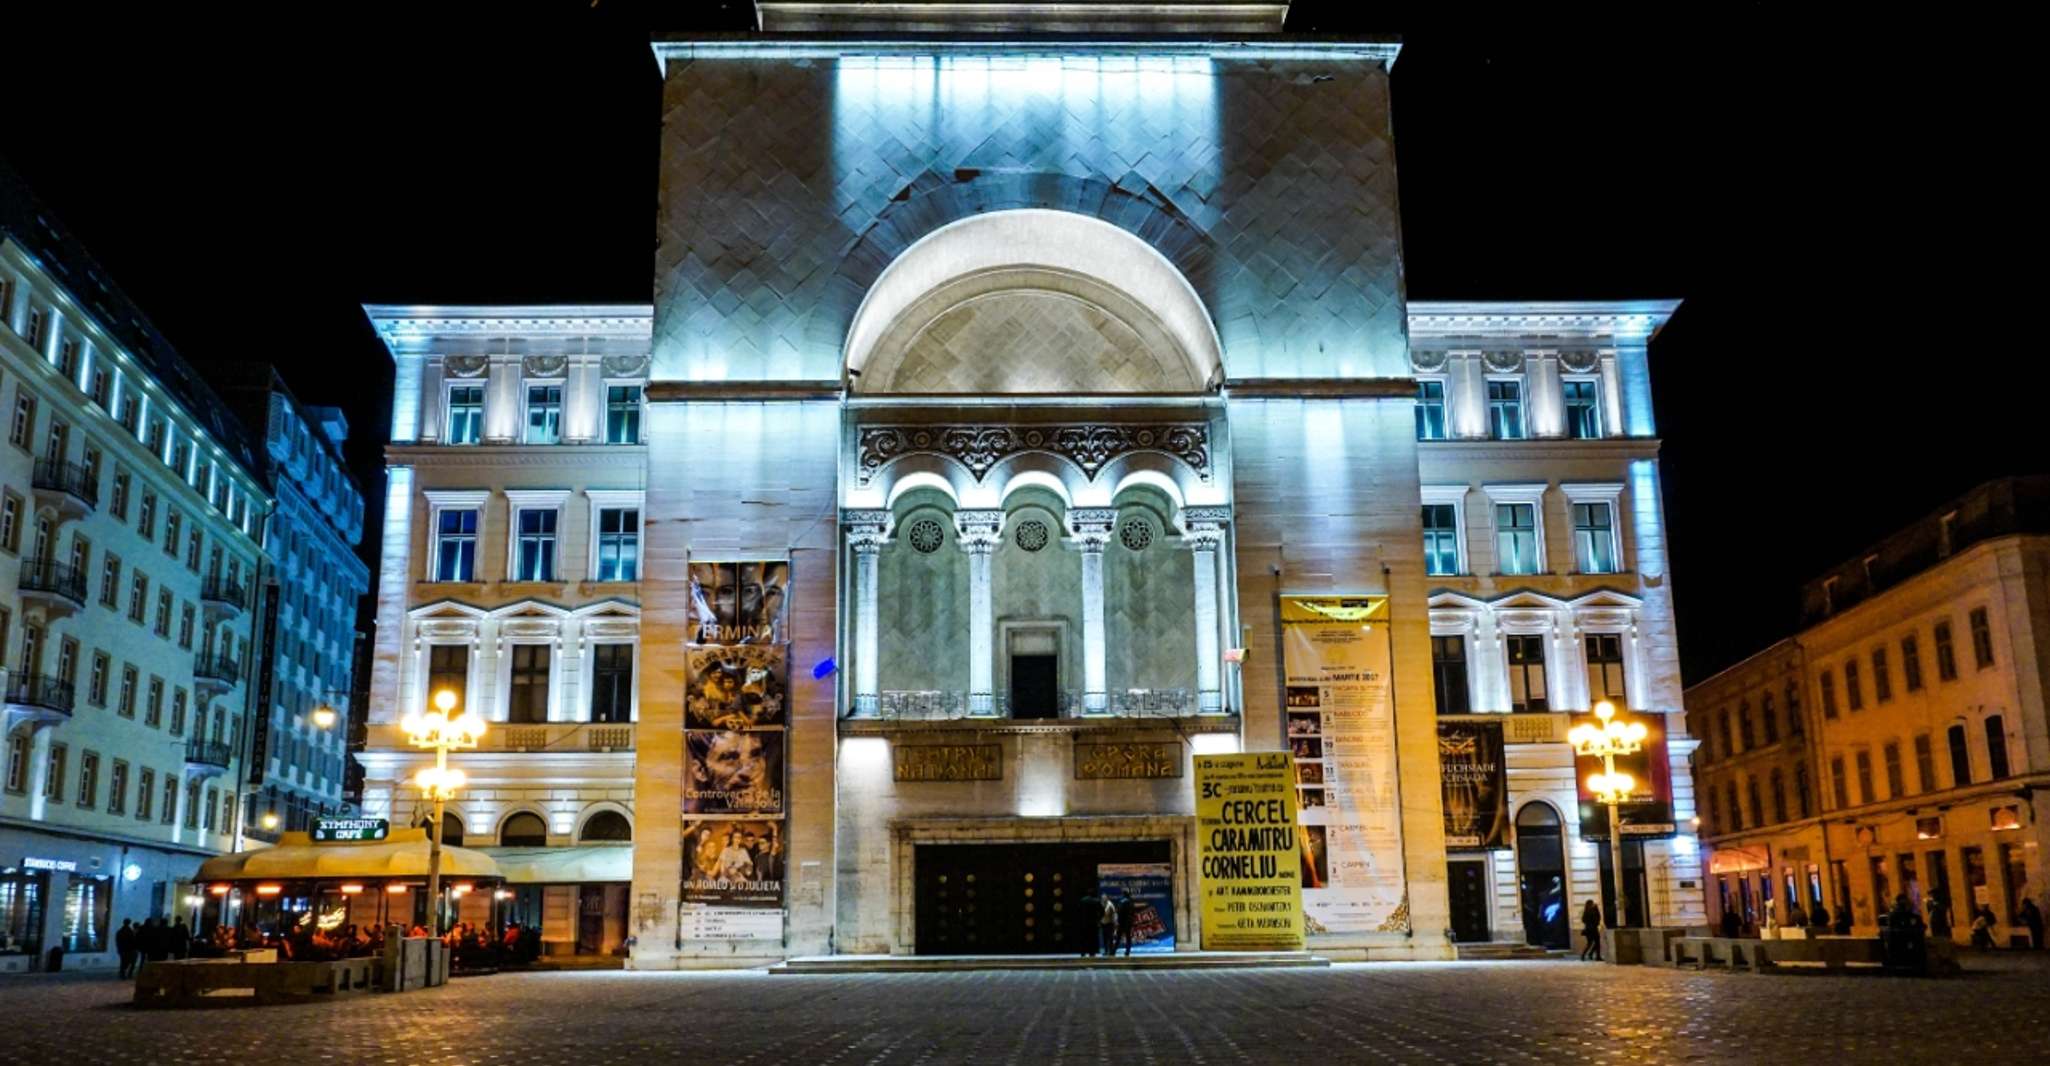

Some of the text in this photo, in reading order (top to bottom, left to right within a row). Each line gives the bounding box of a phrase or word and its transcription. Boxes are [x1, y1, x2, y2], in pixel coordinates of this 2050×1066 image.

[319, 819, 380, 830] SYMPHONY
[1222, 799, 1290, 825] CERCEL
[1212, 826, 1294, 852] CARAMITRU
[1202, 854, 1277, 879] CORNELIU
[745, 880, 781, 892] JULIETA
